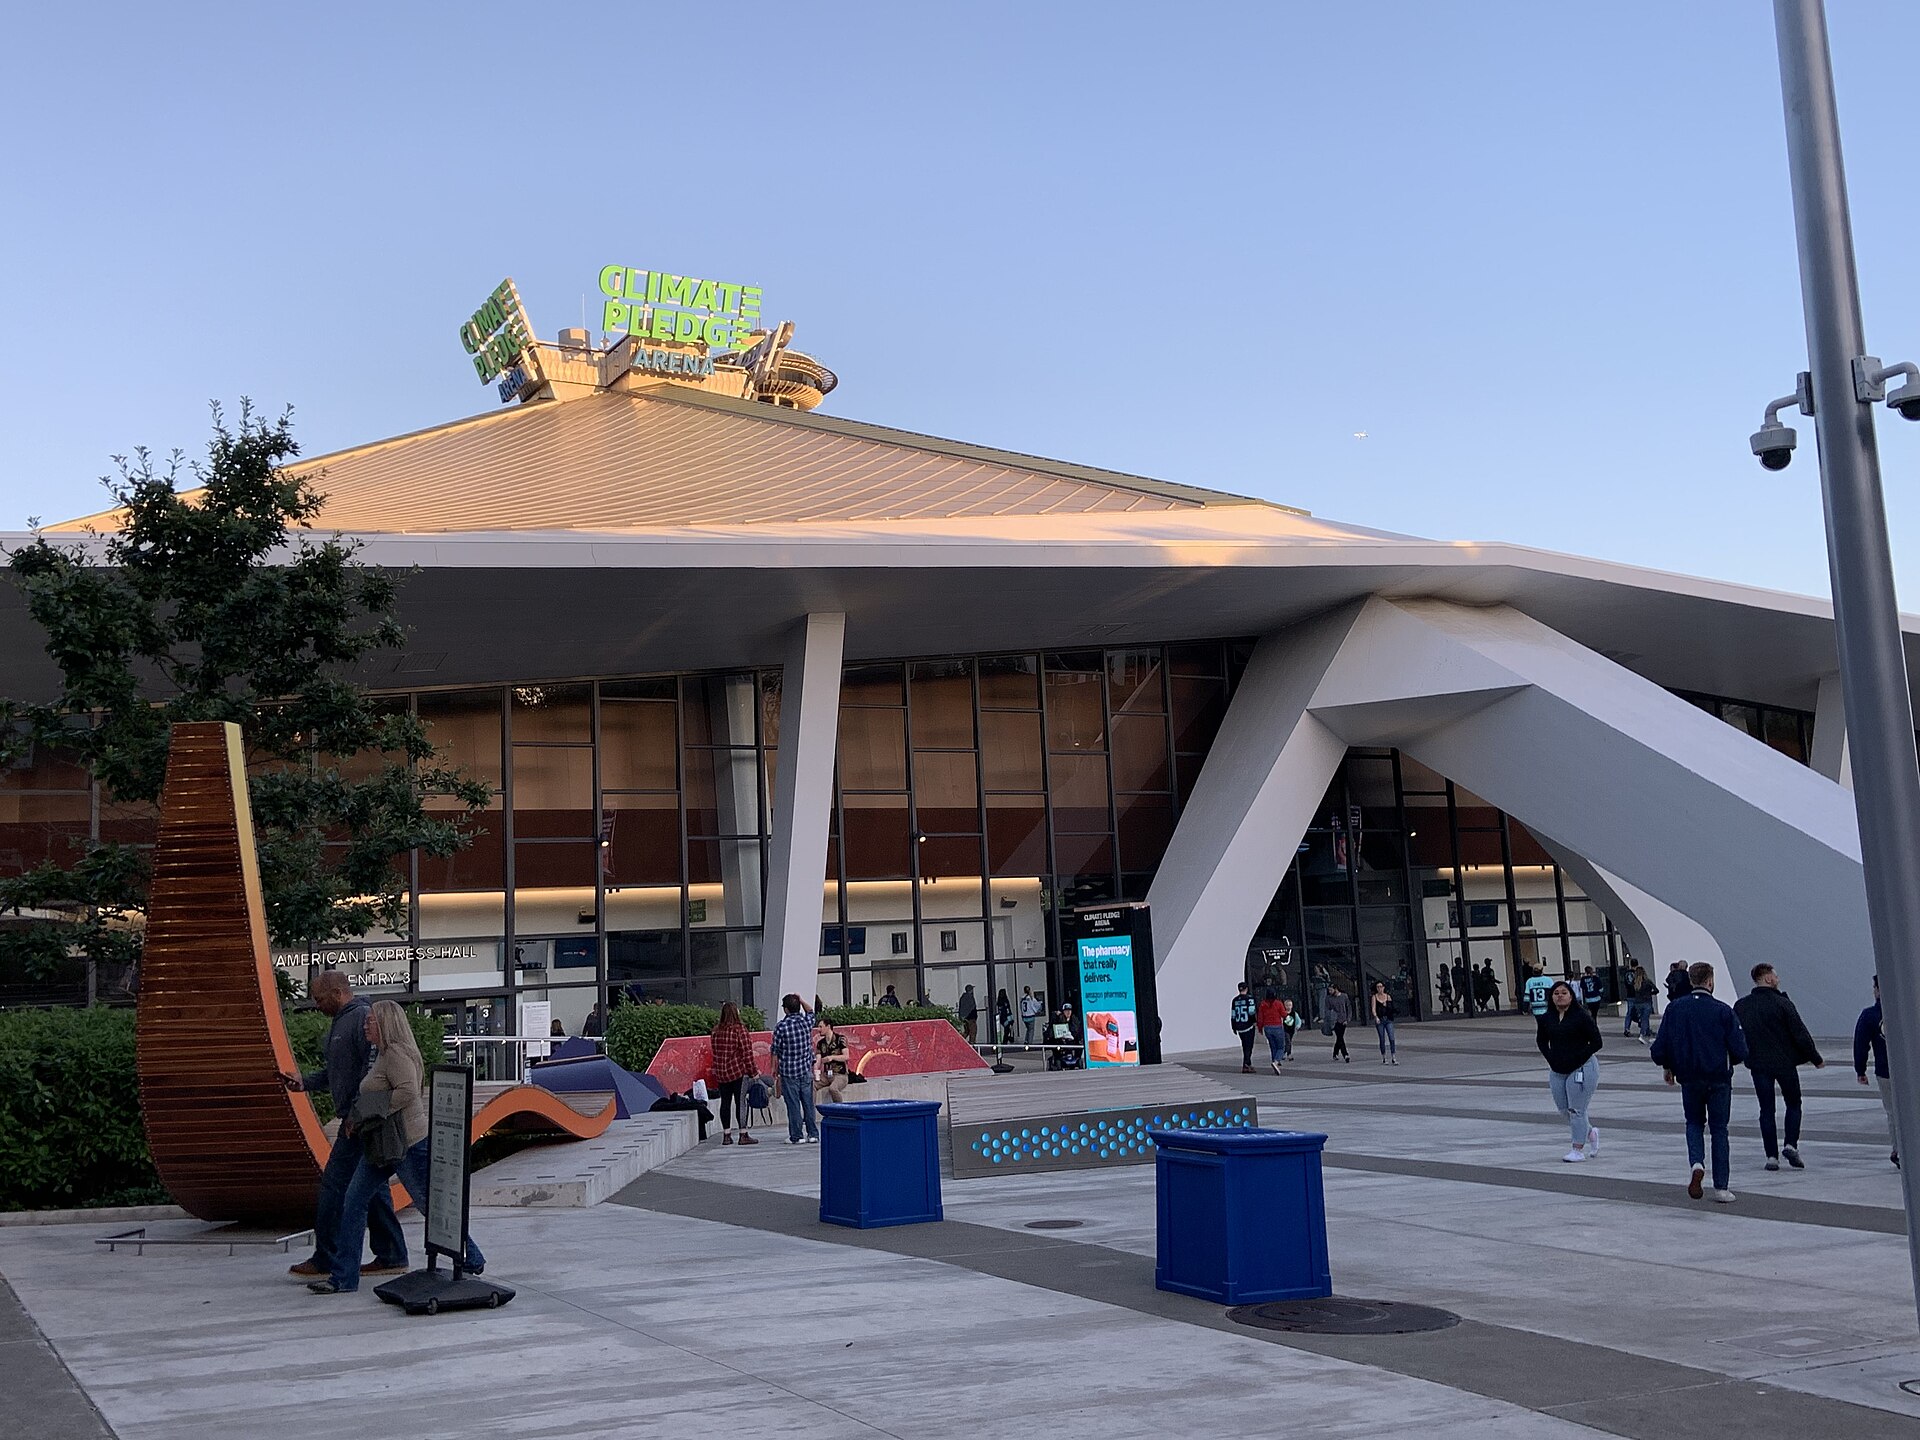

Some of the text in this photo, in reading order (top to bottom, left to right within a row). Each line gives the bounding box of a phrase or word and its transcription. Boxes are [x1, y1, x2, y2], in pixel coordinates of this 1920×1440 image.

[599, 264, 763, 319] CLIMATE
[459, 278, 518, 355] CLIMATE
[602, 300, 752, 352] PLEDGE
[472, 315, 528, 386] PLEDGE
[632, 347, 716, 375] ARENA
[275, 945, 477, 967] AMERICAN EXPRESS HALL
[1082, 944, 1130, 958] The pharmacy
[1083, 958, 1117, 970] that really
[347, 972, 411, 987] ENTRY 3
[1084, 972, 1112, 983] delivers.
[1104, 991, 1127, 1000] pharmacy
[1532, 988, 1545, 1001] 13
[482, 1008, 489, 1018] 3
[1235, 1005, 1248, 1022] 35
